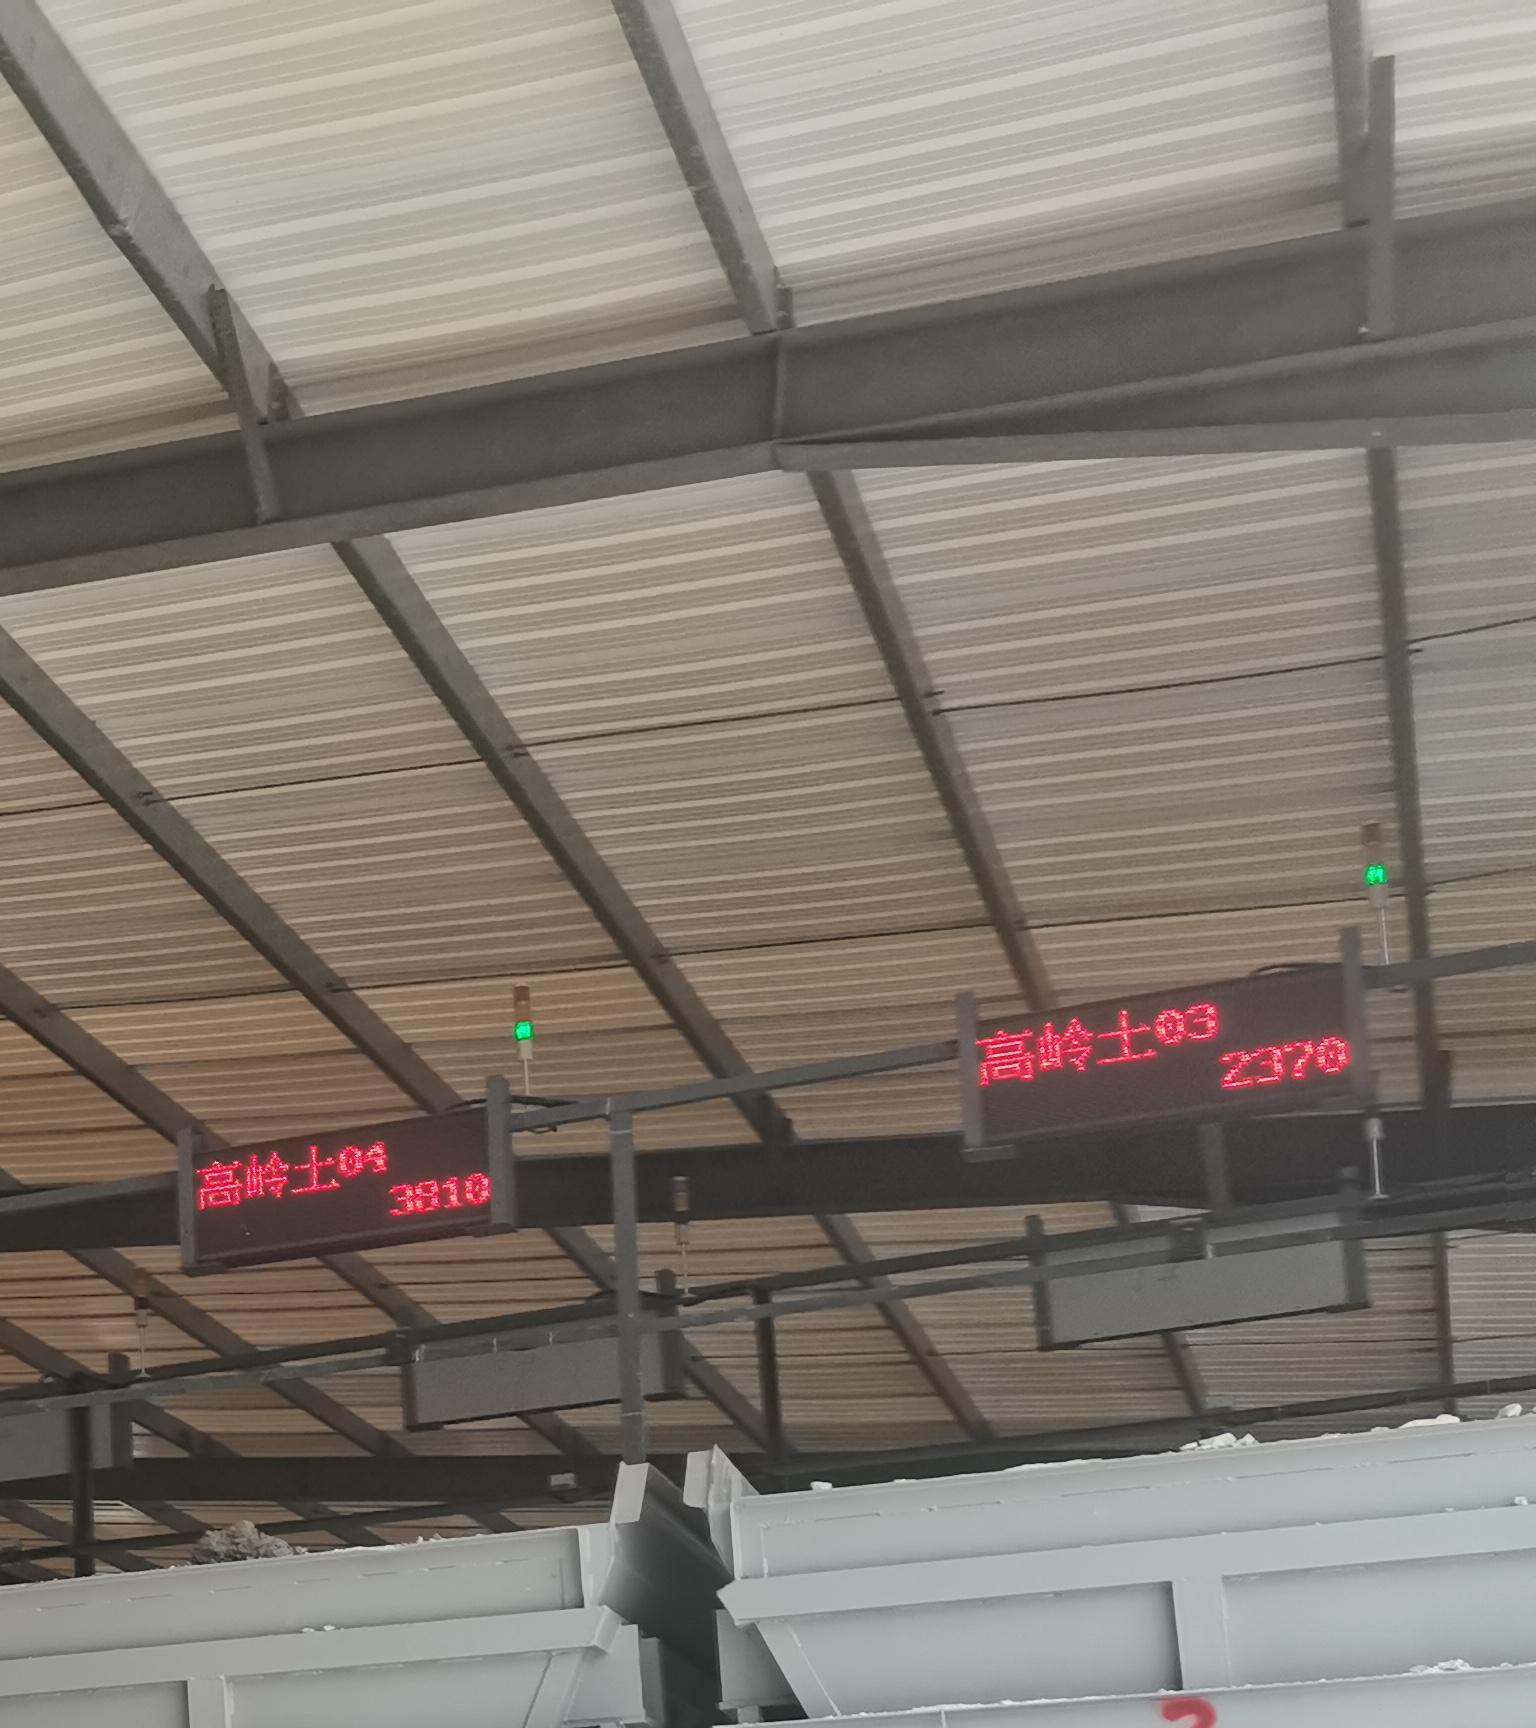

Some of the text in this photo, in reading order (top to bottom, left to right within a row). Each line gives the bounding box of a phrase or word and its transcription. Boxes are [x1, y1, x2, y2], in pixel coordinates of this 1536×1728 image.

[976, 1001, 1220, 1087] 高岭土03
[1218, 1034, 1351, 1090] 2370
[196, 1140, 389, 1211] 高岭土04
[387, 1171, 493, 1217] 3810
